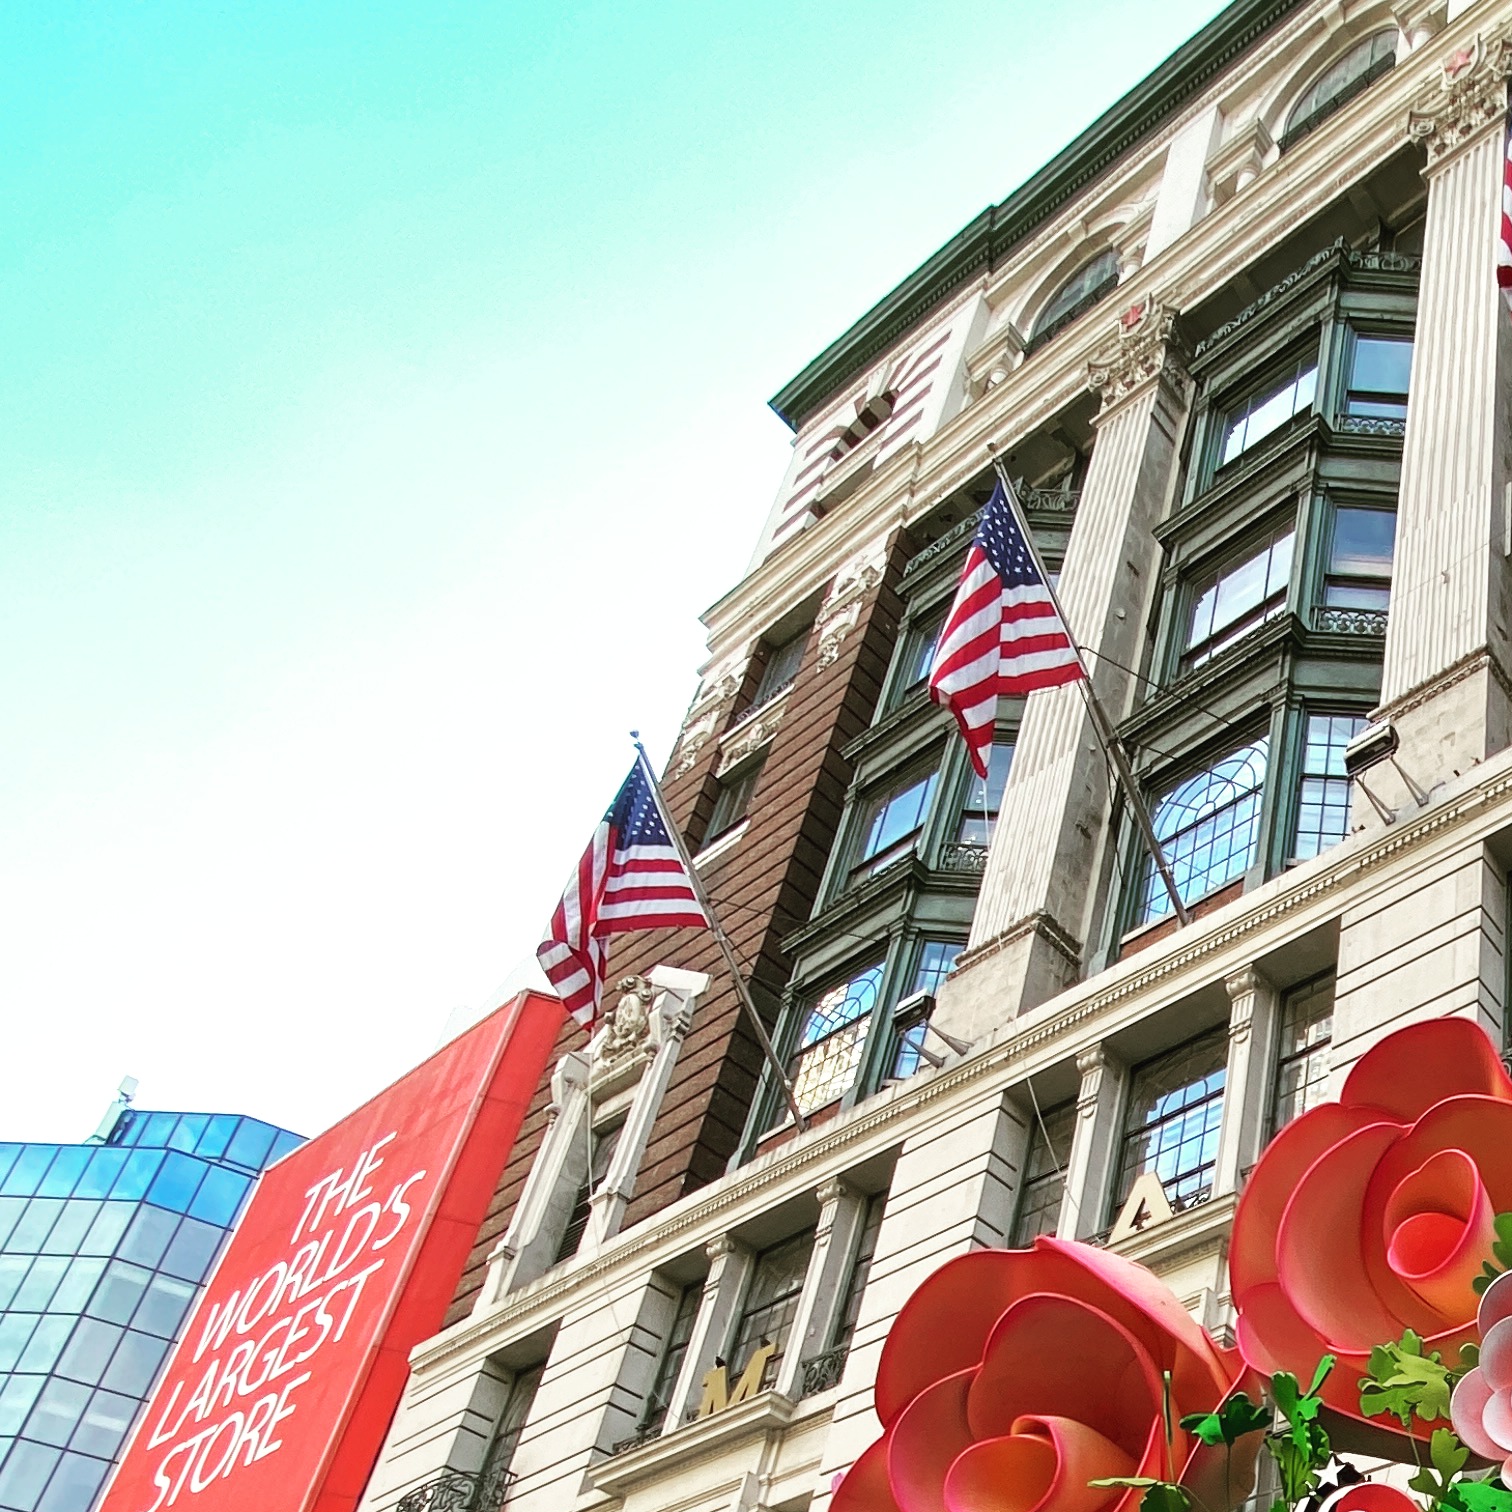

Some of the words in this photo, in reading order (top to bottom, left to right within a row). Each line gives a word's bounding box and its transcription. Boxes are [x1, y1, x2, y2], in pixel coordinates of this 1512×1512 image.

[193, 1170, 426, 1363] WORLD'S
[291, 1131, 397, 1244] THE
[147, 1259, 385, 1450] LARGEST
